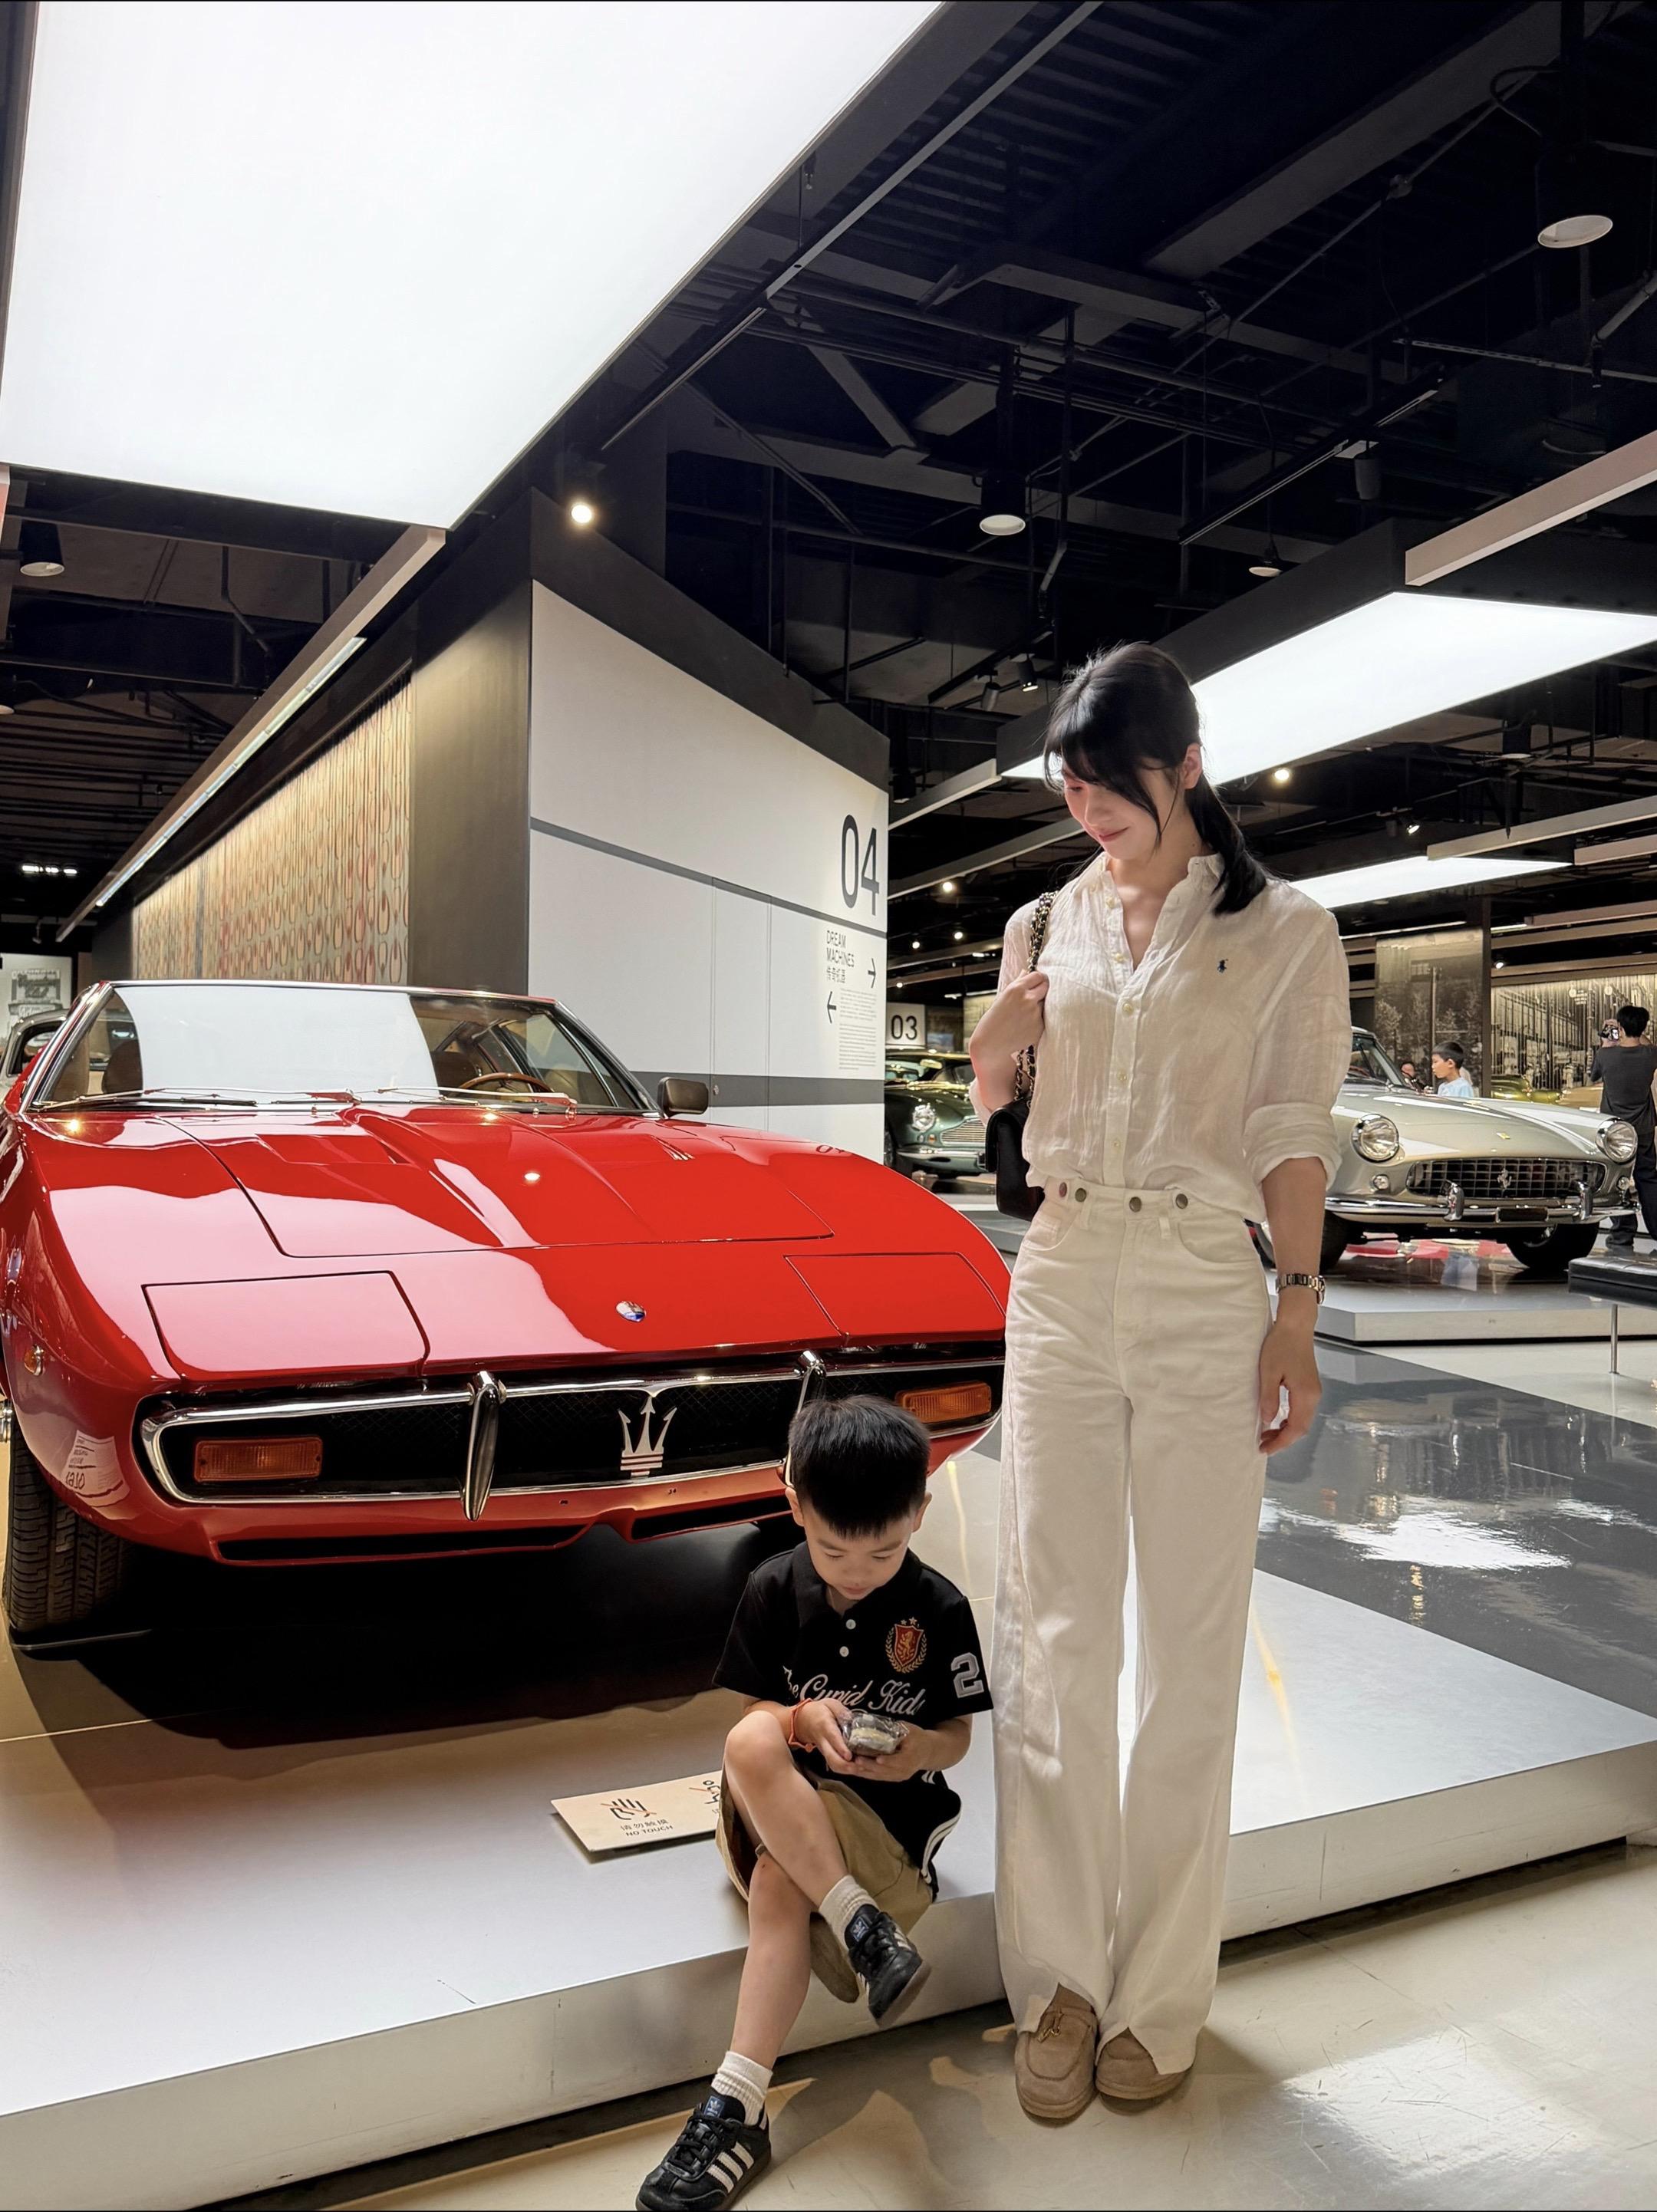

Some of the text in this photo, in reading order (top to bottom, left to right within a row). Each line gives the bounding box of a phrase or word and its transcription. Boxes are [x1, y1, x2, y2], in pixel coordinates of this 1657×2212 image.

[842, 814, 879, 916] 04
[891, 1015, 917, 1040] 03
[950, 1651, 984, 1698] 2
